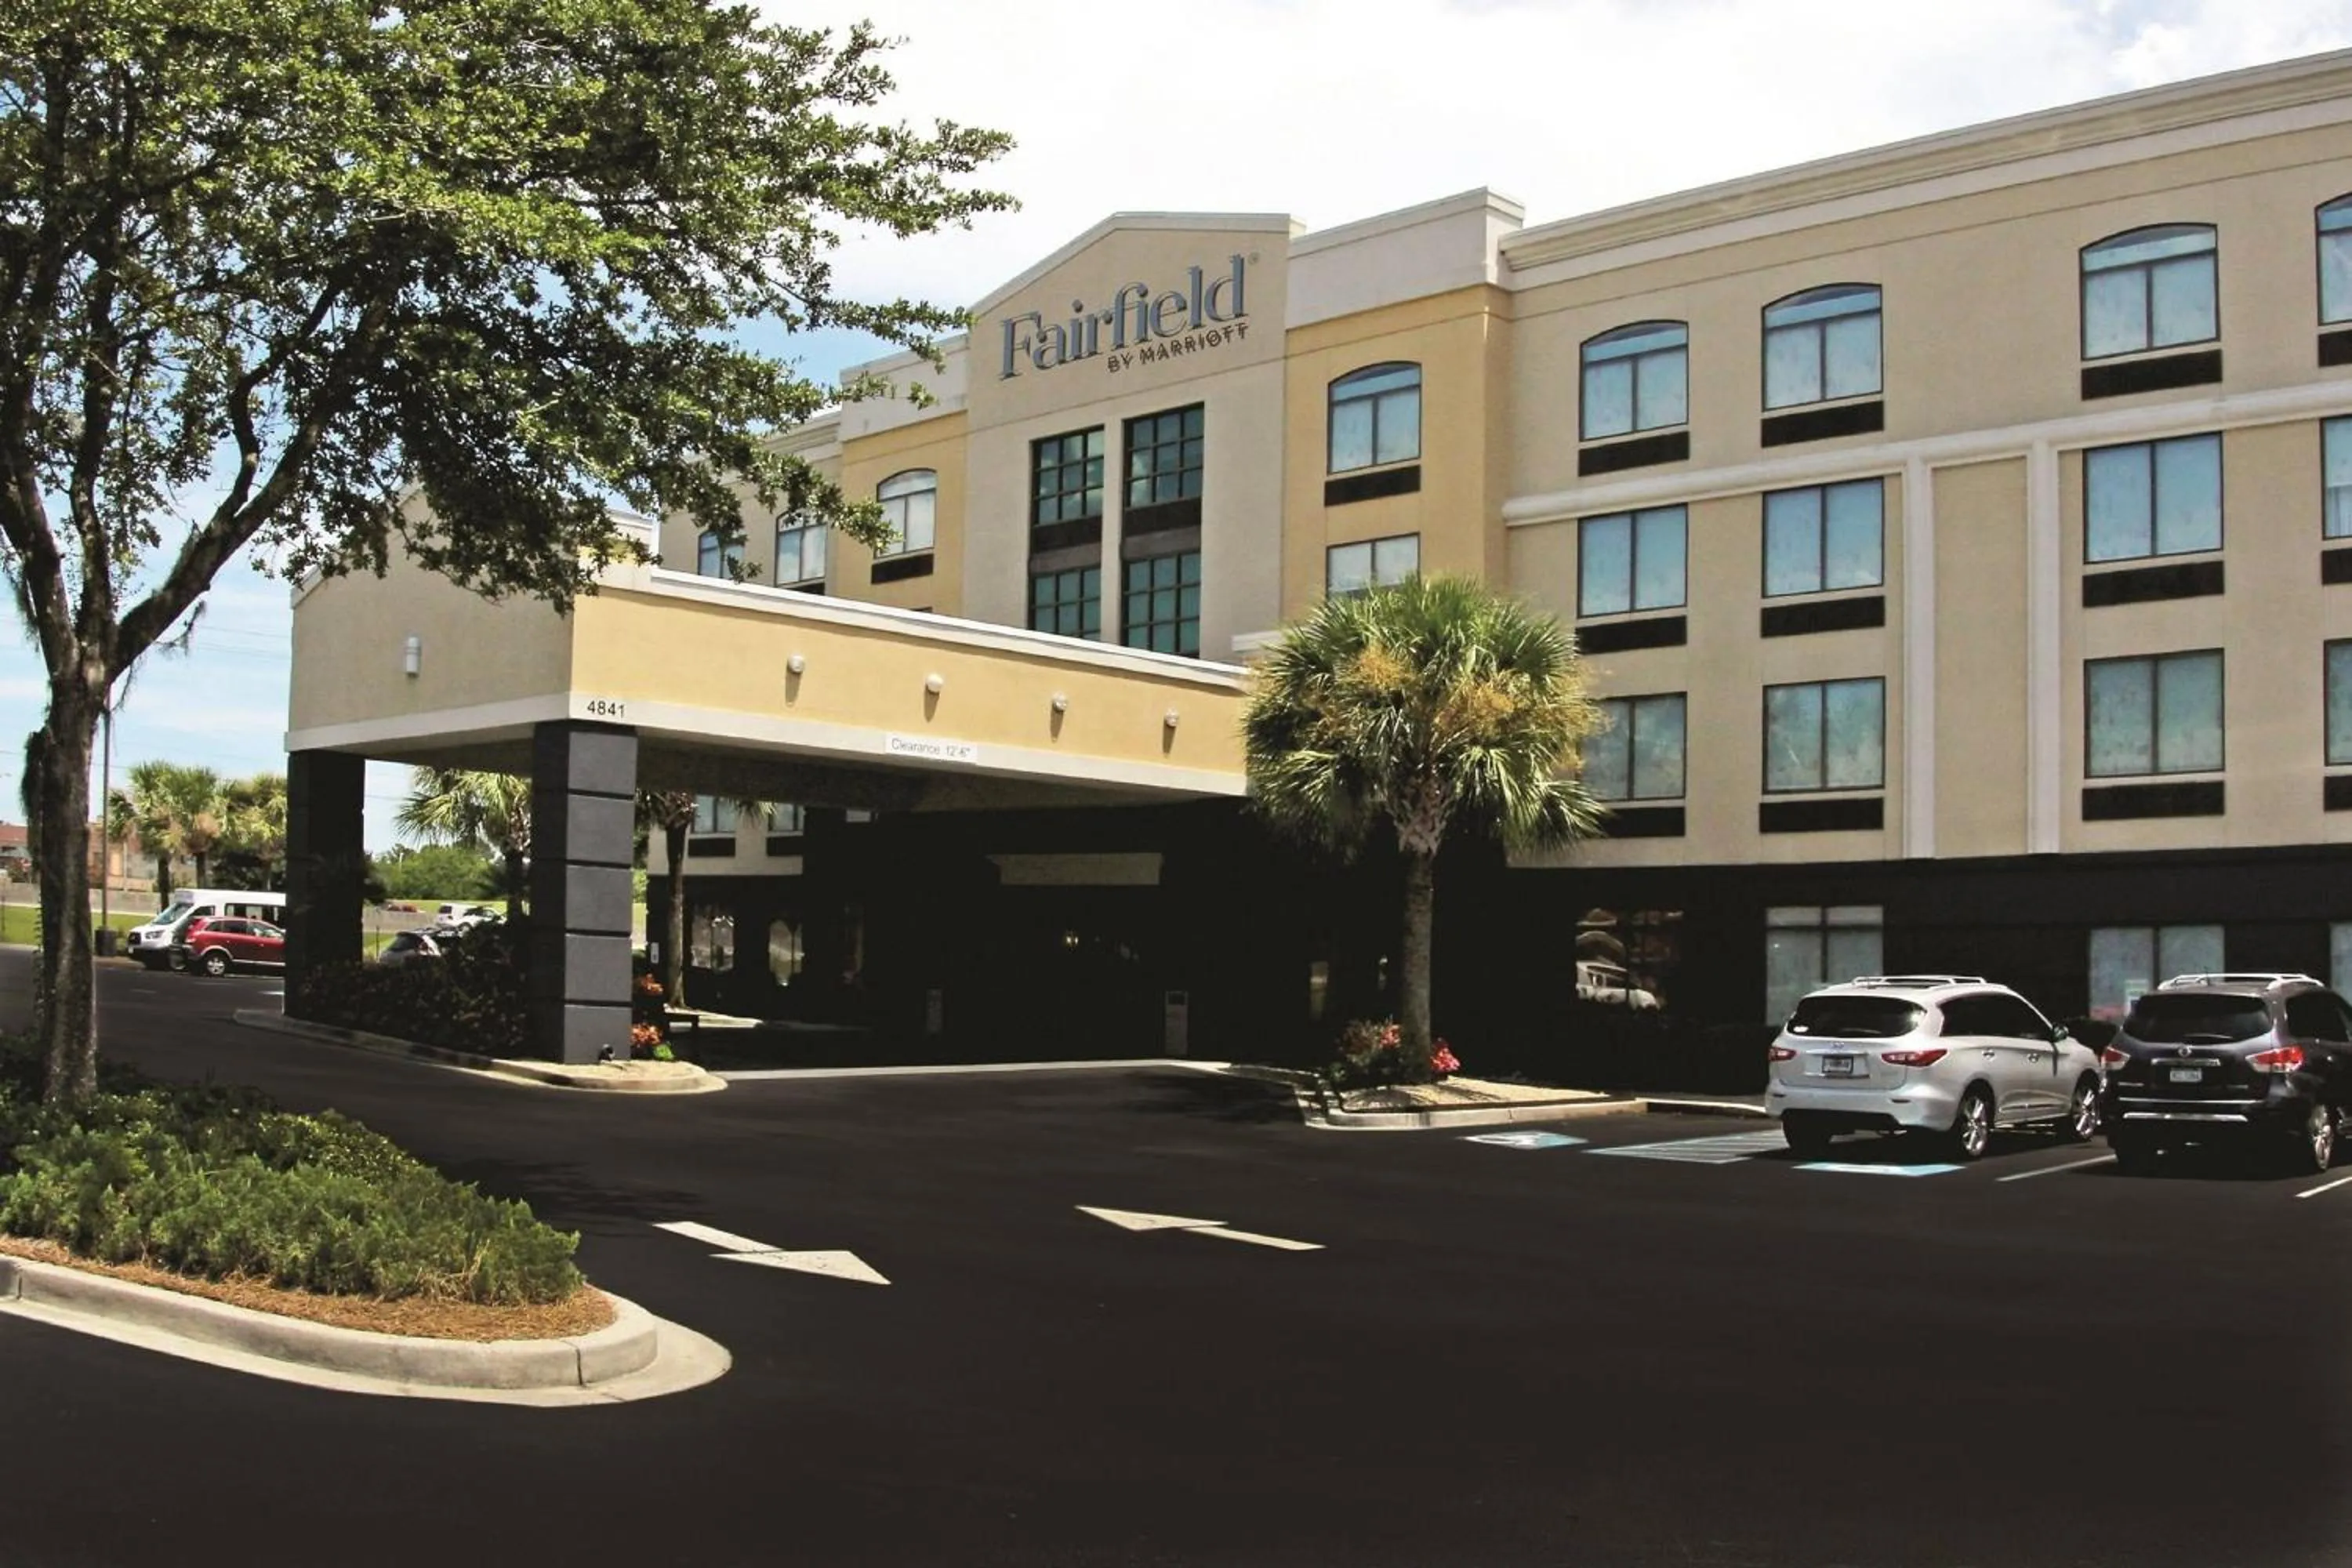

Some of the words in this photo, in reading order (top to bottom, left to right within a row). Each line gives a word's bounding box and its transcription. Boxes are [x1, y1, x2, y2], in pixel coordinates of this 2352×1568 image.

[1000, 253, 1249, 380] Fairfield
[1107, 352, 1134, 373] BY
[1139, 322, 1250, 365] MARRIOTT
[587, 700, 626, 718] 4841
